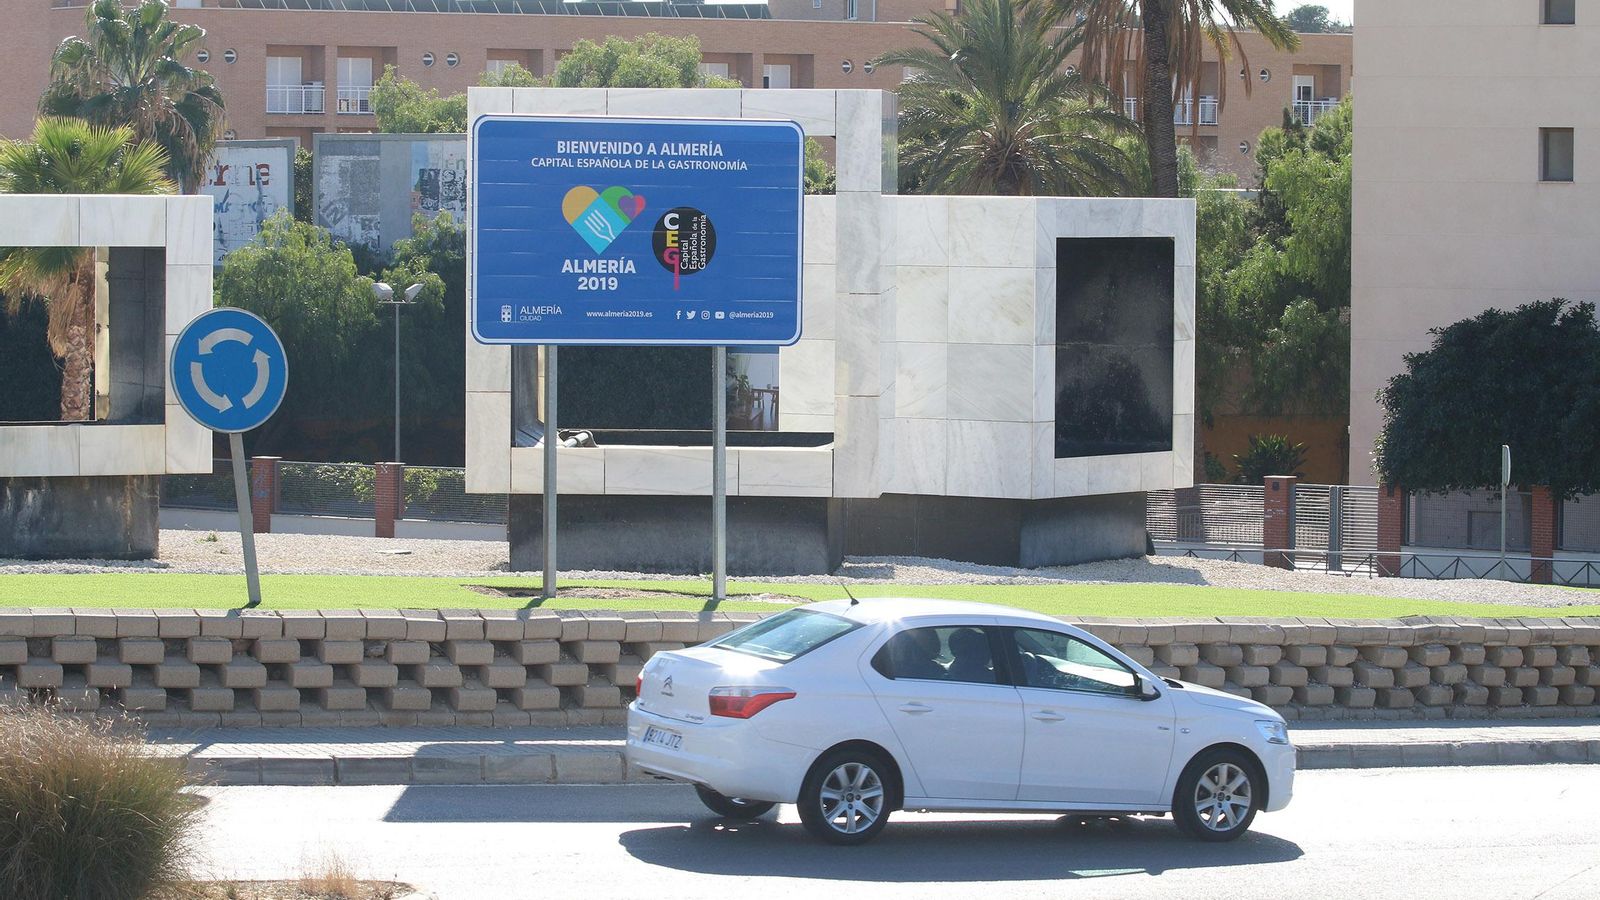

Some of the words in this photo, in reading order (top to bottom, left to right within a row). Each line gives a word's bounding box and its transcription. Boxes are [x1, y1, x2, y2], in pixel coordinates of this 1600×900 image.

[557, 140, 644, 155] BIENVENIDO
[647, 143, 657, 155] A
[660, 141, 724, 157] ALMERÍA
[531, 157, 575, 168] CAPITAL
[577, 157, 632, 169] ESPAÑOLA
[635, 159, 649, 169] DE
[652, 159, 665, 169] LA
[668, 159, 748, 171] GASTRONOMÍA
[692, 223, 698, 231] de
[698, 214, 707, 270] Gastronomía
[680, 240, 690, 270] Capital
[689, 233, 699, 270] Española
[561, 256, 637, 274] ALMERÍA
[577, 276, 618, 291] 2019
[520, 304, 562, 315] ALMERÍA
[586, 310, 653, 318] www.almeria2019.es
[729, 311, 774, 319] @almeria2019
